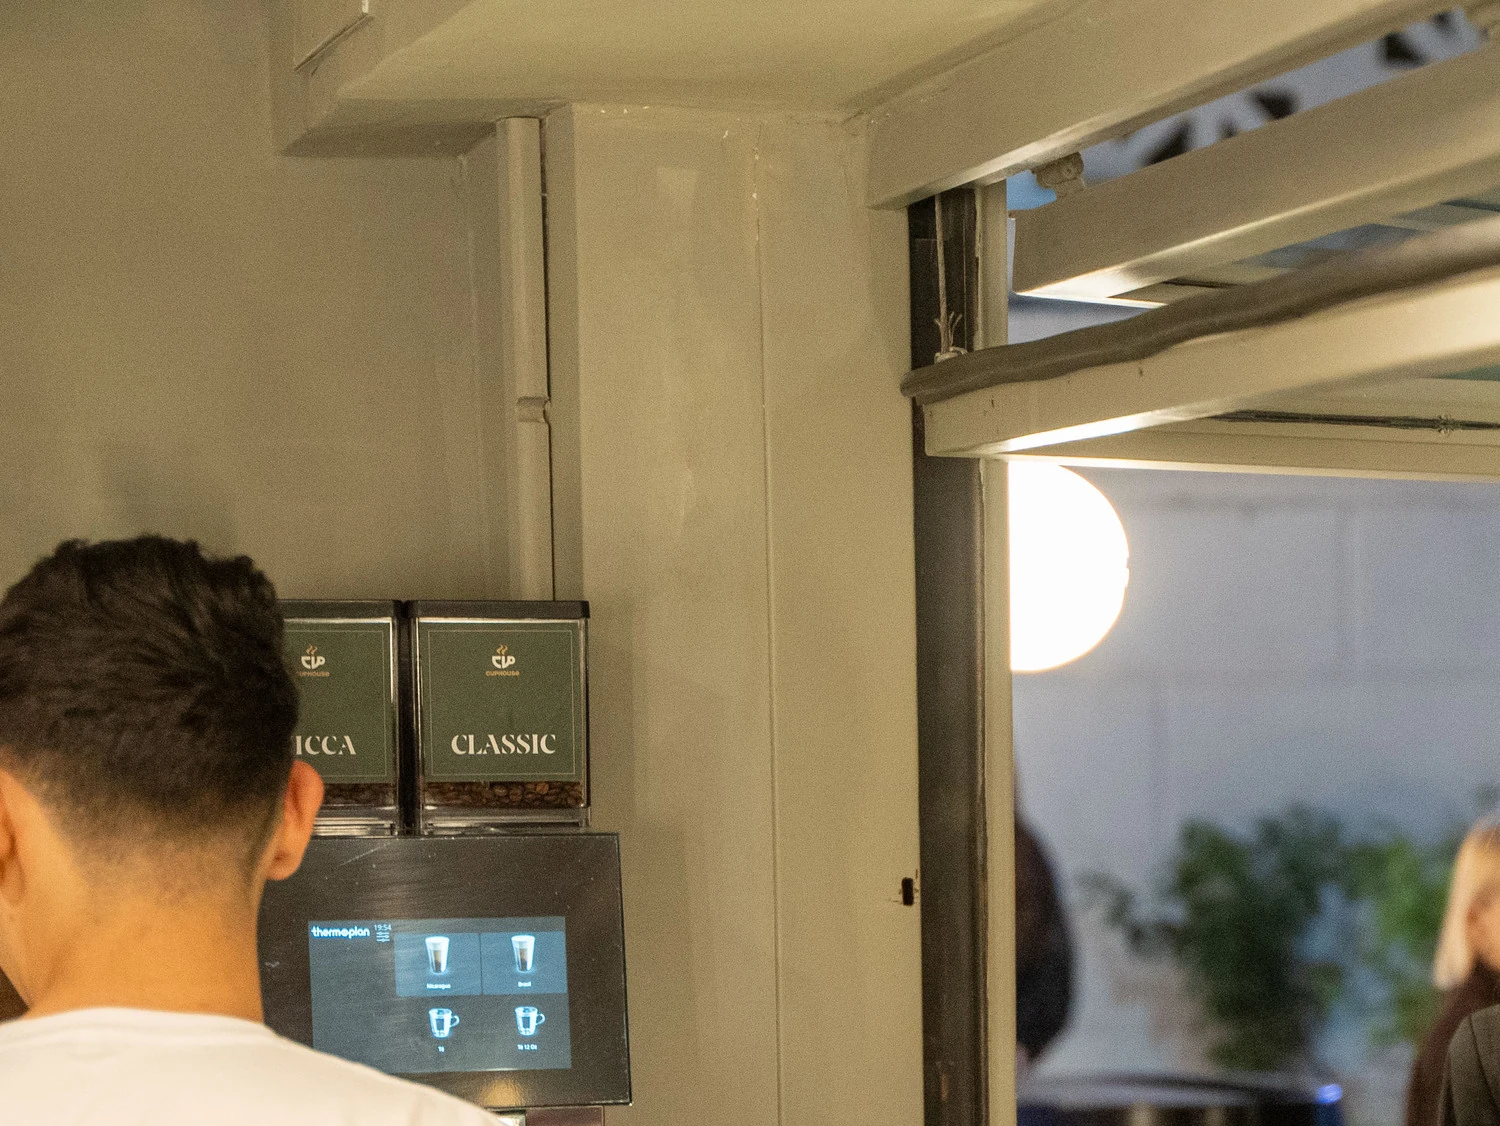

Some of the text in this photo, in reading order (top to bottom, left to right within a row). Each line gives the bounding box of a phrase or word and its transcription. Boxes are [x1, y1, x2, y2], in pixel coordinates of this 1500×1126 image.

[292, 735, 357, 755] ICCA
[450, 733, 556, 755] CLASSIC
[311, 925, 370, 939] thermoplan
